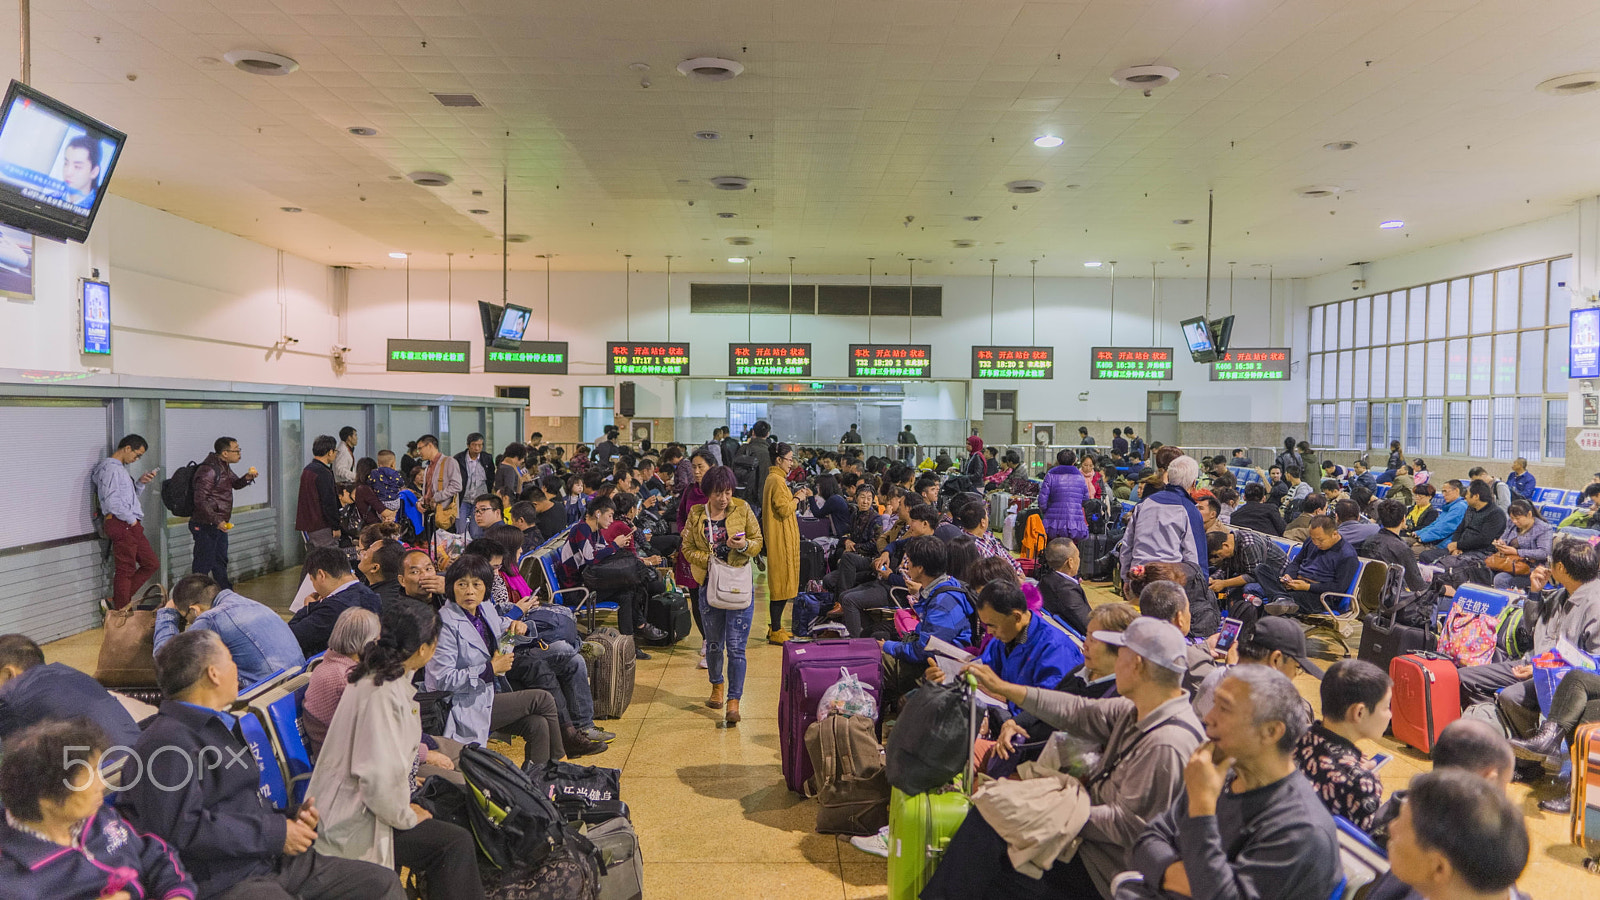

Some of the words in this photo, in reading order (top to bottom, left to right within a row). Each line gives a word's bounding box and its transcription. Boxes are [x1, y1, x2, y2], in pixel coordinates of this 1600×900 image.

[613, 347, 628, 355] 车次
[634, 347, 650, 355] 开点
[650, 347, 666, 355] 站台
[668, 347, 684, 355] 状态
[735, 348, 750, 356] 车次
[756, 348, 771, 356] 开点
[772, 348, 787, 356] 站台
[789, 348, 805, 356] 状态
[854, 349, 870, 357] 车次
[876, 349, 891, 357] 开点
[892, 349, 907, 357] 站台
[909, 349, 925, 357] 状态
[977, 351, 993, 359] 车次
[998, 351, 1014, 359] 开点
[1014, 351, 1030, 359] 站台
[1032, 351, 1047, 359] 状态
[1097, 351, 1113, 360] 车次
[1118, 352, 1133, 360] 开点
[1134, 352, 1149, 360] 站台
[1151, 352, 1167, 360] 状态
[1237, 353, 1252, 361] 开点
[1138, 361, 1144, 369] 2
[1256, 362, 1262, 370] 2
[1457, 596, 1490, 614] 新生植发
